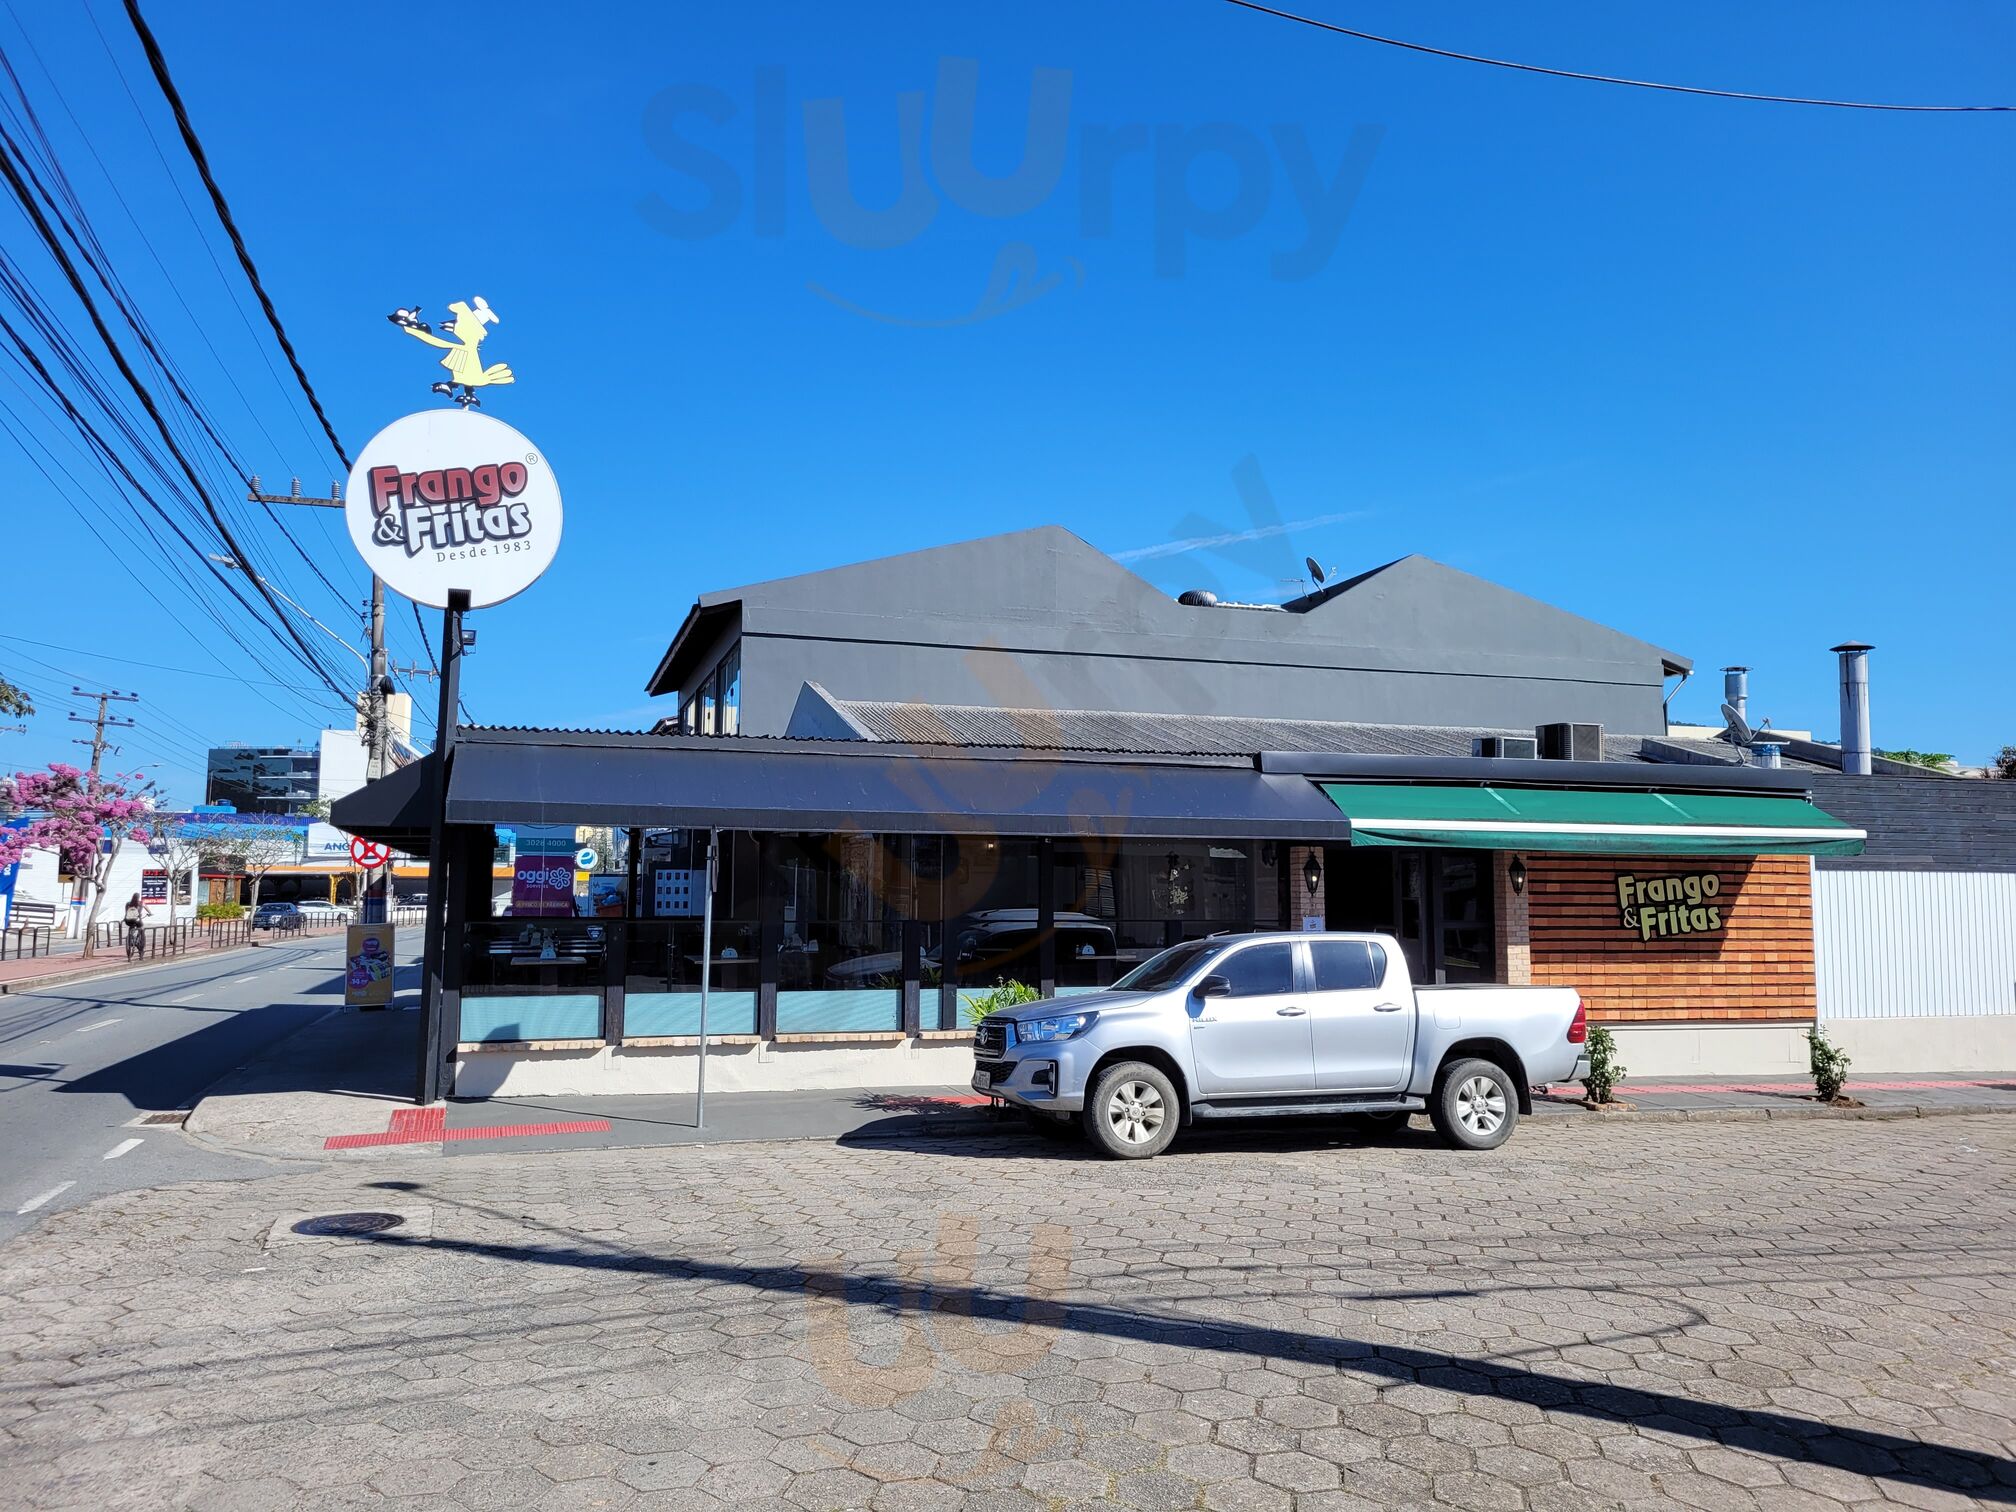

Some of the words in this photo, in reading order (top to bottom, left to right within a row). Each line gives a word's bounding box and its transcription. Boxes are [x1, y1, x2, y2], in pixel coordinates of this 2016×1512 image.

[367, 461, 529, 517] Frango
[372, 512, 406, 547] &
[402, 502, 532, 559] Fritas
[437, 546, 487, 563] Desde
[494, 540, 532, 556] 1983
[517, 867, 549, 884] oggi
[1616, 873, 1721, 910] Frango
[1624, 907, 1640, 929] &
[1639, 904, 1723, 942] Fritas
